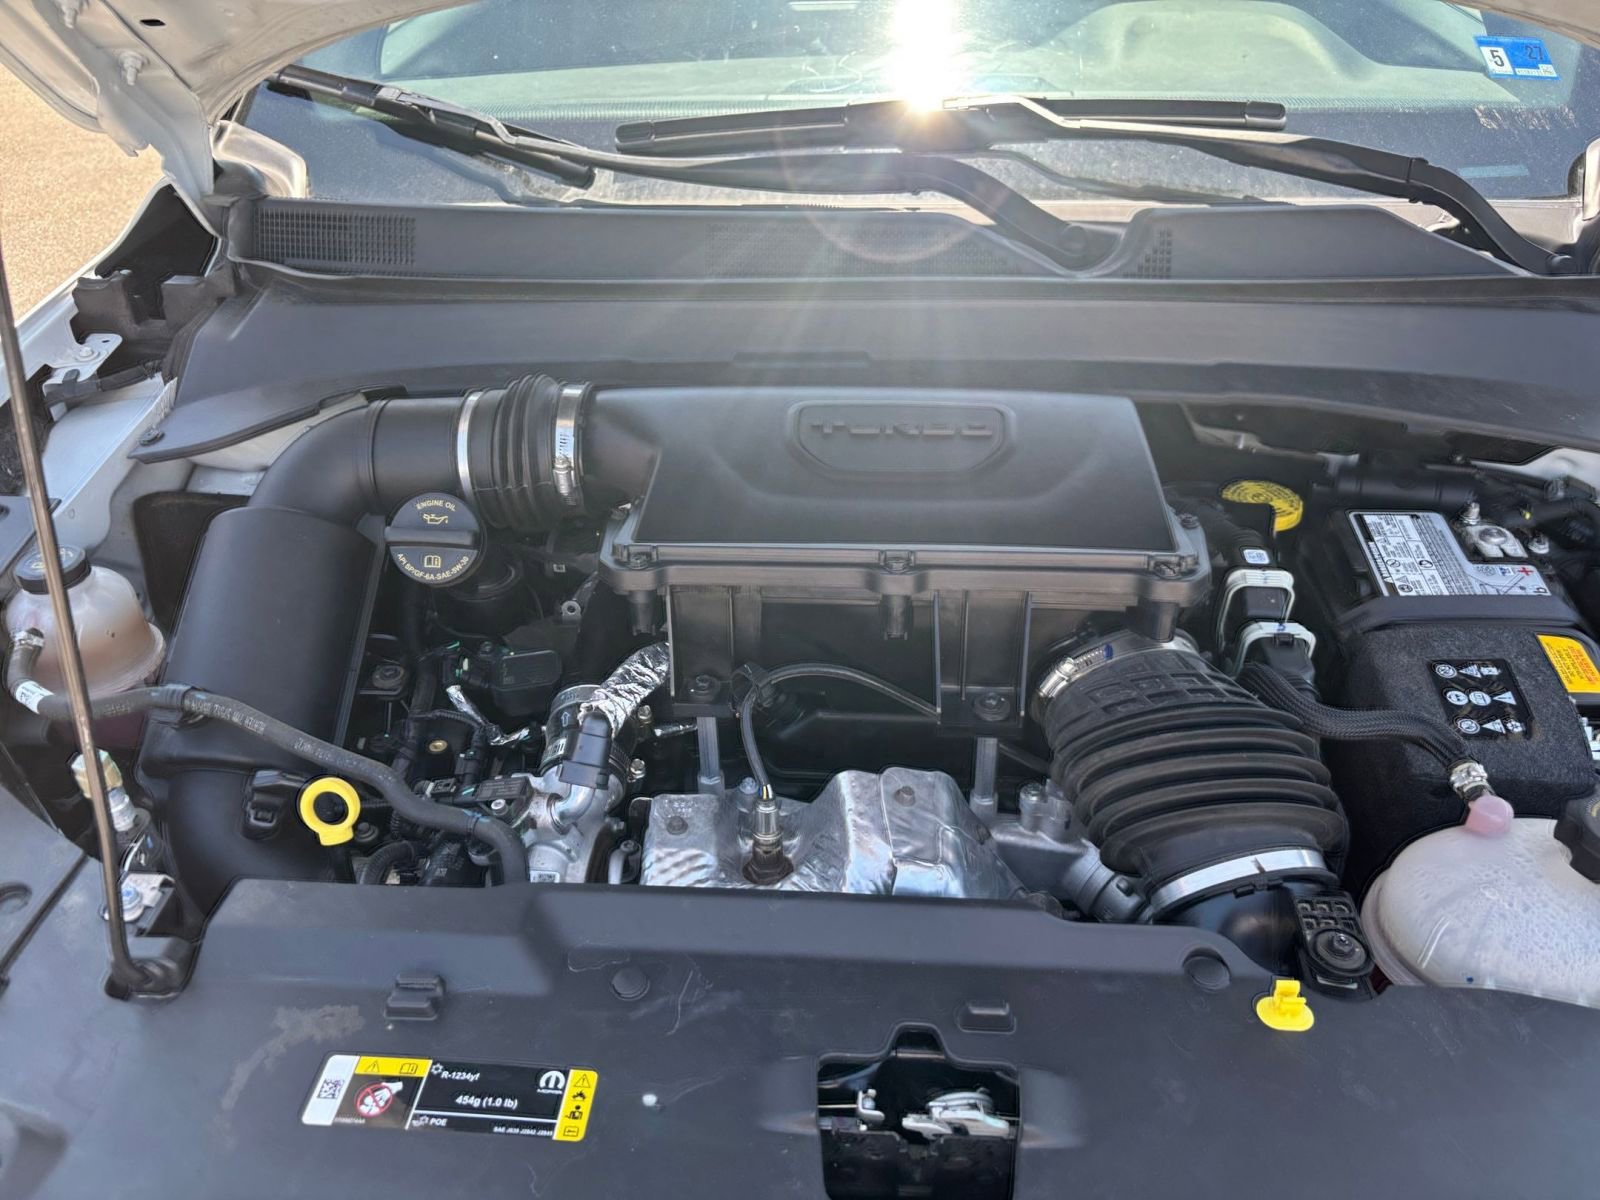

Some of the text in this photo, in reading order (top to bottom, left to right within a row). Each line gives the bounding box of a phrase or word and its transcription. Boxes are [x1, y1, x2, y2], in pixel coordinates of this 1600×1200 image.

[1489, 45, 1543, 67] 5 27
[416, 500, 456, 512] ENGINE OIL
[441, 1070, 480, 1083] R-1234yf
[455, 1095, 518, 1110] 454g (1.0 lb)
[429, 1117, 447, 1126] POE
